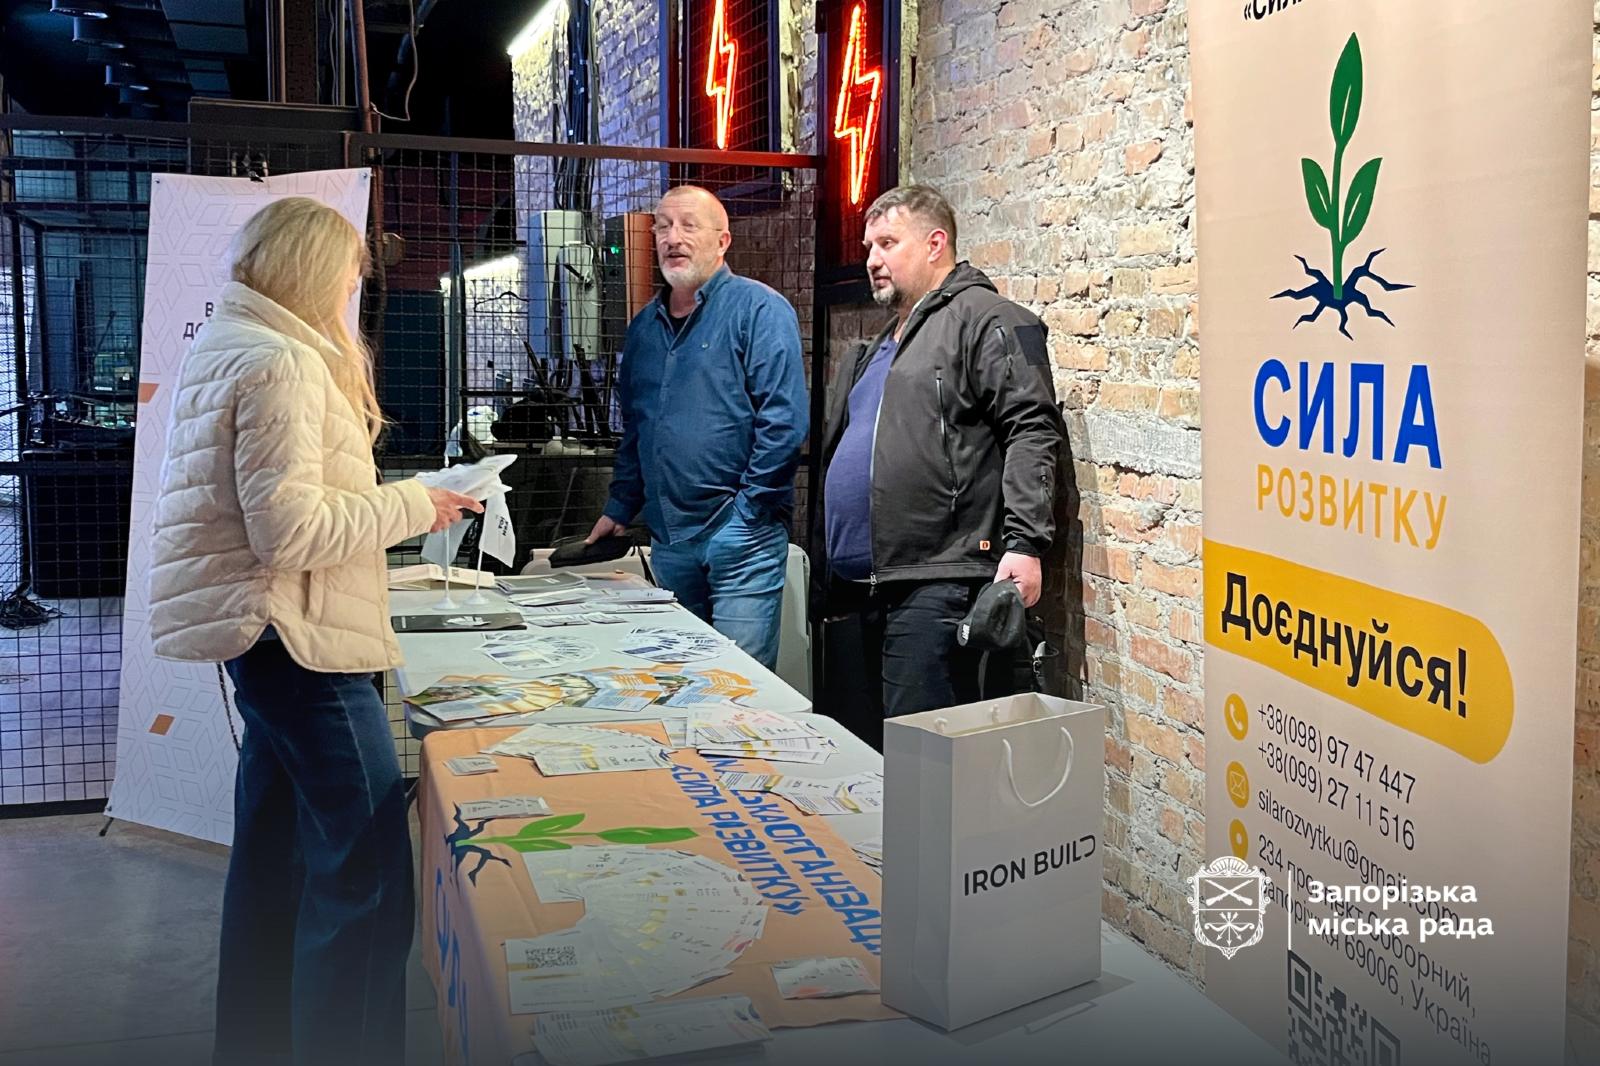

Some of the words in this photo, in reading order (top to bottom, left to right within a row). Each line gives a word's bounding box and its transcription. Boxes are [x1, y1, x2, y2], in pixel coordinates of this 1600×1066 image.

[1254, 358, 1442, 469] СИЛА
[1257, 463, 1447, 551] РОЗВИТКУ
[1221, 571, 1467, 719] Доєднуйся!
[1258, 703, 1323, 763] +38(098)
[1327, 736, 1349, 768] 97
[1354, 750, 1375, 782] 47
[1379, 764, 1416, 803] 447
[1258, 741, 1323, 803] +38(099)
[1327, 777, 1349, 810] 27
[1356, 792, 1372, 826] 11
[1379, 806, 1415, 851] 516
[964, 857, 1026, 897] IRON
[1034, 834, 1096, 876] BUILD
[1259, 834, 1283, 872] 234
[1411, 979, 1492, 1066] Україна
